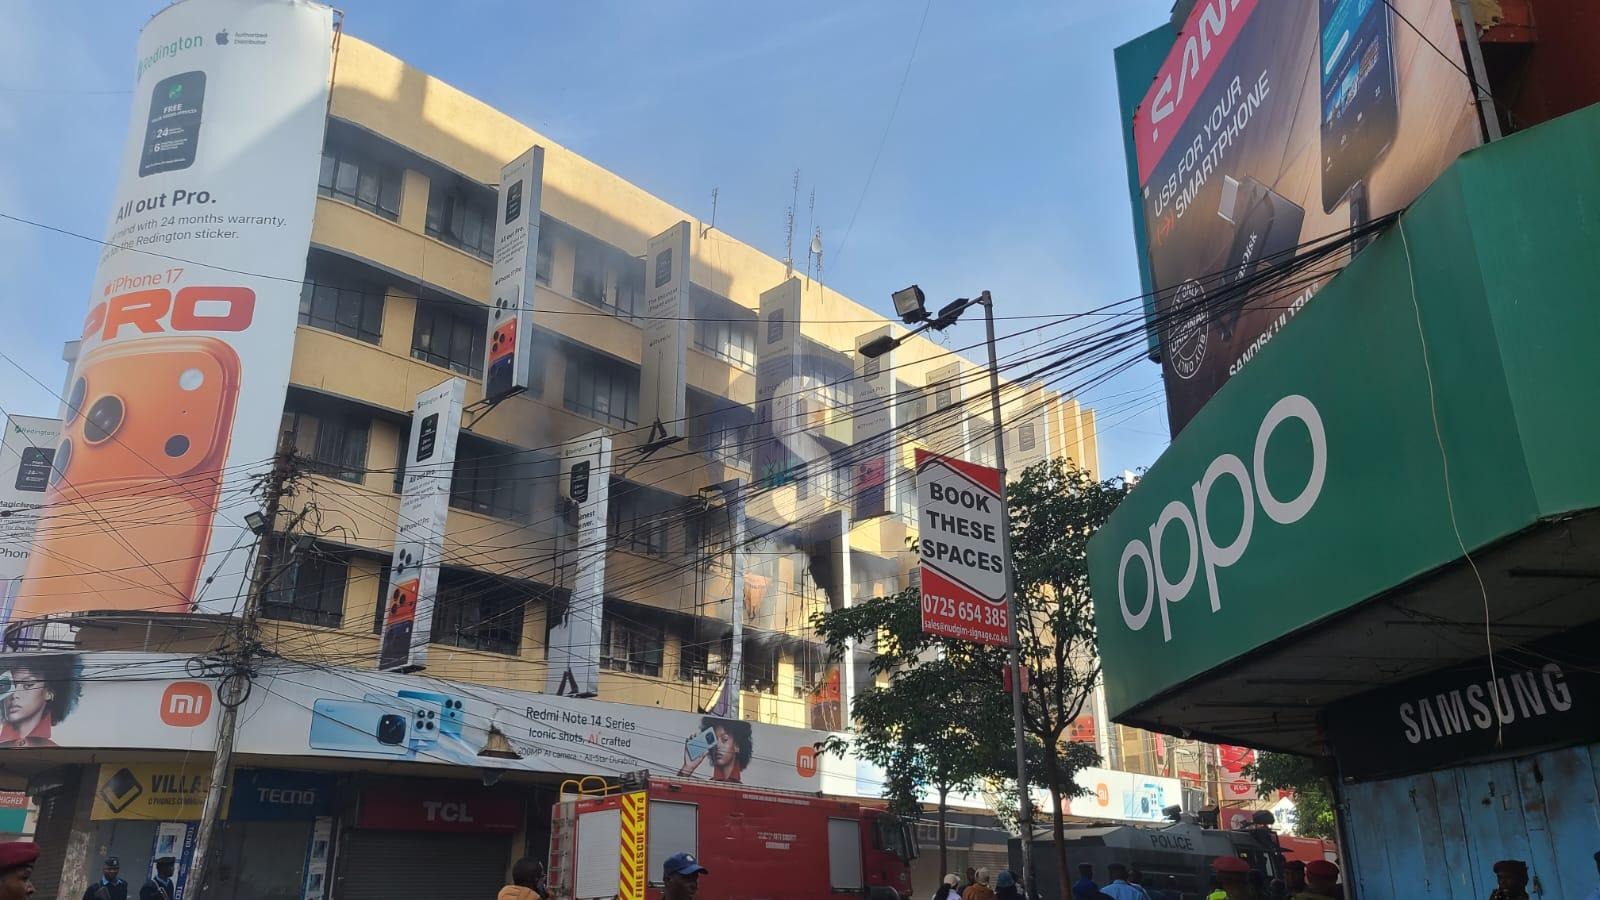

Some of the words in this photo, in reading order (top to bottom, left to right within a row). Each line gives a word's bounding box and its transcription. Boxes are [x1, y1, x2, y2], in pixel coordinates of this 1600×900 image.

[1152, 0, 1239, 143] SAN
[164, 104, 183, 114] FREE
[154, 144, 160, 152] 6
[156, 128, 168, 138] 24
[1155, 172, 1178, 217] USB
[1178, 134, 1203, 184] FOR
[1204, 75, 1242, 141] YOUR
[1176, 70, 1270, 218] SMARTPHONE
[116, 200, 132, 224] All
[136, 192, 167, 214] out
[172, 190, 217, 206] Pro.
[136, 232, 192, 246] Redington
[194, 228, 240, 239] sticker.
[137, 220, 158, 233] with
[160, 216, 175, 227] 24
[178, 214, 224, 224] months
[228, 216, 288, 228] warranty.
[112, 272, 162, 294] iPhone
[166, 268, 184, 284] 17
[84, 286, 256, 342] PRO
[930, 482, 991, 514] BOOK
[926, 510, 996, 544] THESE
[1118, 394, 1328, 642] oppo
[922, 538, 1003, 574] SPACES
[924, 594, 956, 618] 0725
[958, 602, 982, 623] 654
[984, 606, 1007, 628] 385
[526, 706, 560, 722] Redmi
[562, 711, 588, 725] Note
[590, 714, 602, 726] 14
[606, 716, 636, 730] Series
[1400, 663, 1573, 744] SAMSUNG
[528, 728, 556, 740] Iconic
[559, 730, 585, 744] shots,
[600, 736, 631, 748] crafted
[257, 788, 315, 806] TECNO
[422, 801, 474, 822] TCL
[636, 830, 644, 872] RESCUE
[1150, 834, 1194, 851] POLICE
